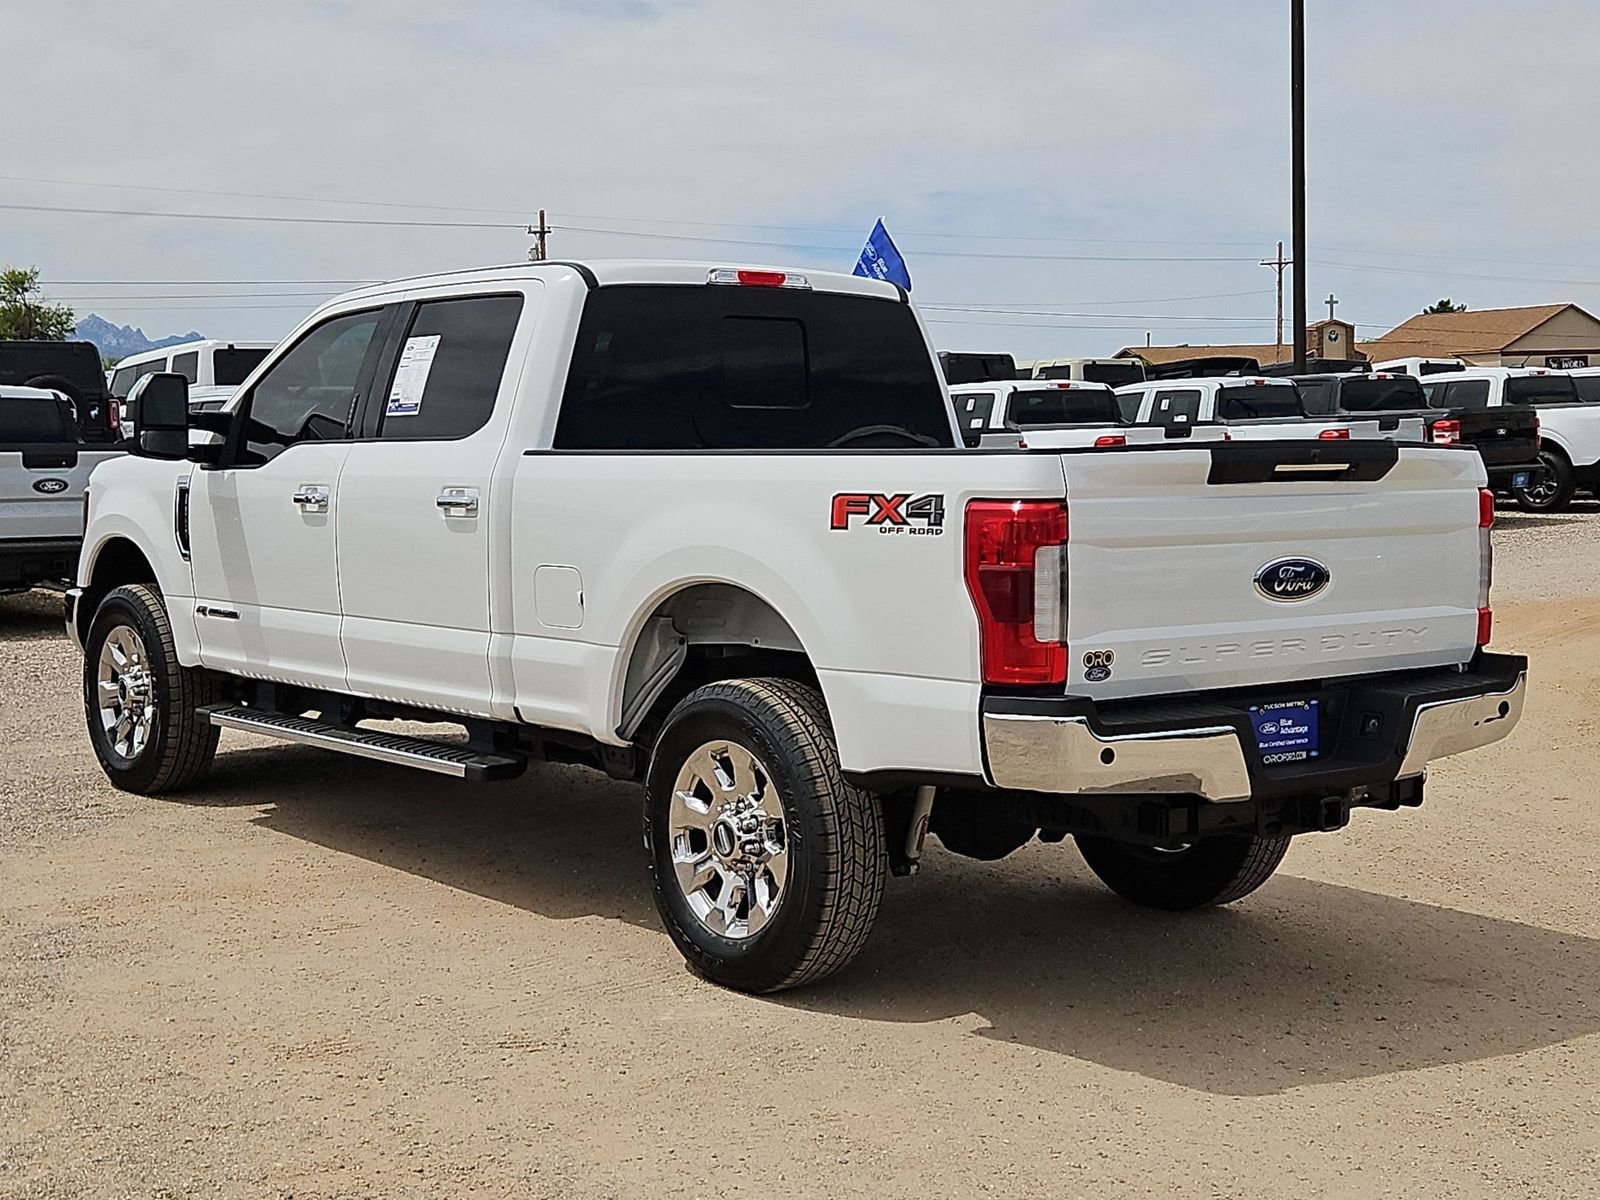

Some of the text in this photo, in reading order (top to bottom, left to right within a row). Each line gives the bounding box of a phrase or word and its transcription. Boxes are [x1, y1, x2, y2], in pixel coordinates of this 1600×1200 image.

[830, 493, 945, 530] FX4
[879, 526, 944, 536] OFF ROAD
[1141, 627, 1428, 667] SUPER DUTY
[1084, 651, 1114, 667] ORO
[1280, 718, 1293, 726] Blue
